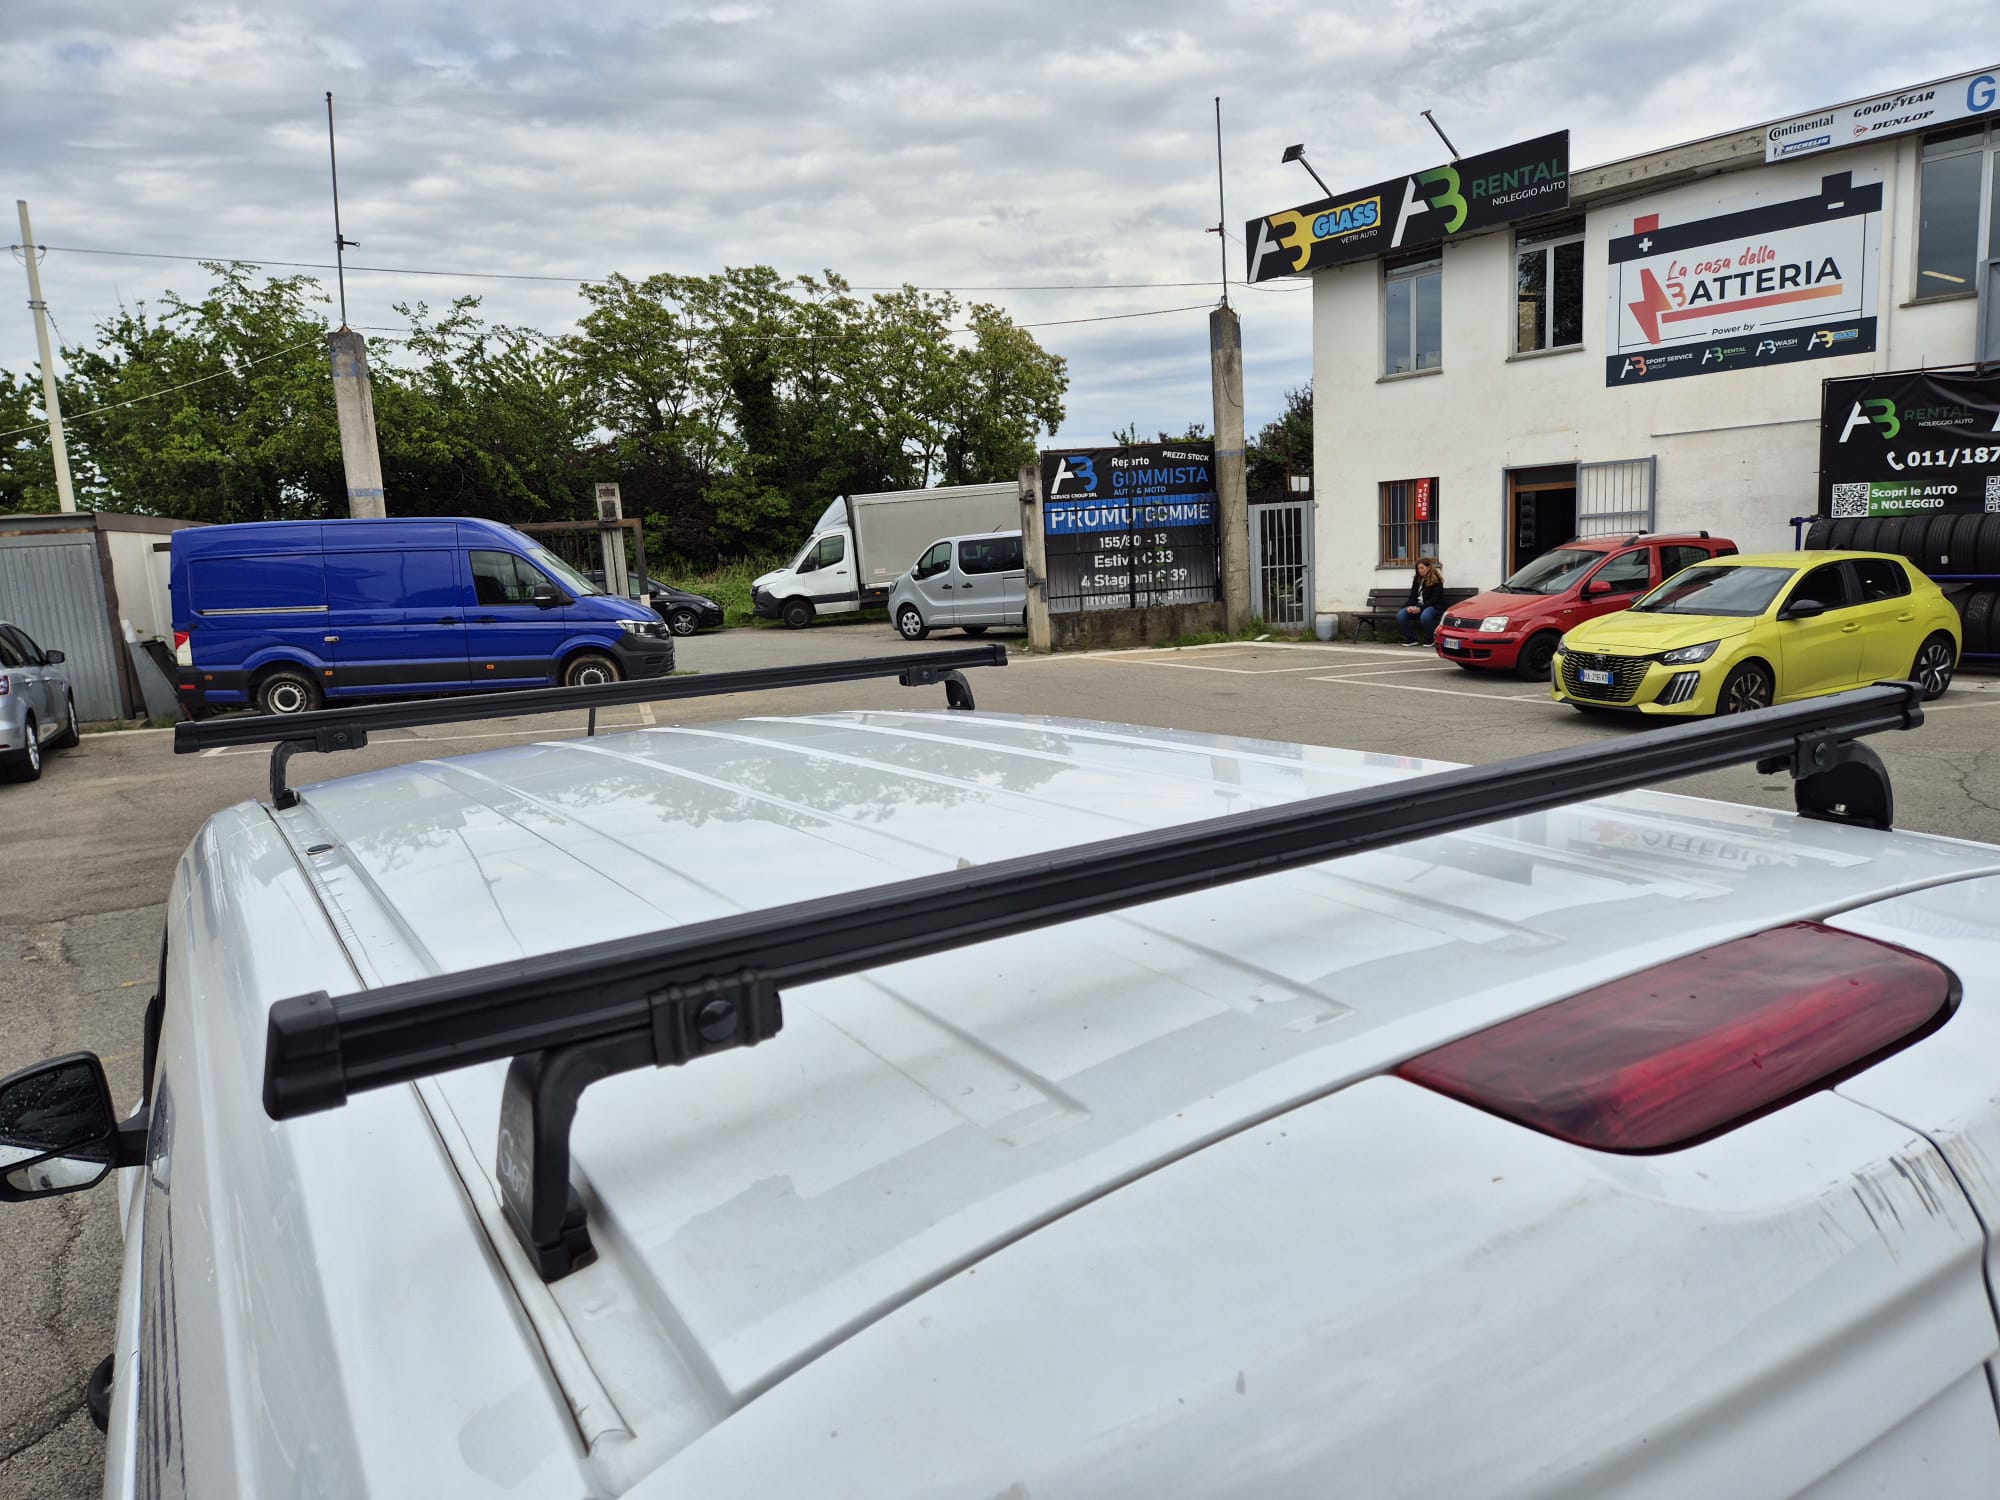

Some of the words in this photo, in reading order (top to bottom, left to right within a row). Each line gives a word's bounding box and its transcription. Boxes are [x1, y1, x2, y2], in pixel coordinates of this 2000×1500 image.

[1967, 75, 1996, 112] G
[1853, 91, 1935, 118] GOODYEAR
[1769, 114, 1834, 141] Continental
[1871, 110, 1934, 131] DUNLOP
[1784, 137, 1829, 152] MICHELIN
[1472, 158, 1567, 200] RENTAL
[1492, 188, 1538, 206] NOLEGGIO
[1540, 180, 1566, 195] AUTO
[1312, 201, 1378, 238] GLASS
[1341, 234, 1358, 244] VETRI
[1360, 230, 1378, 240] AUTO
[1667, 260, 1687, 281] La
[1694, 256, 1731, 275] casa
[1739, 245, 1775, 267] della
[1711, 324, 1740, 336] Power
[1742, 322, 1755, 333] by
[1775, 338, 1798, 347] WASH
[1646, 357, 1666, 365] SPORT
[1667, 353, 1693, 362] SERVICE
[1904, 405, 1973, 421] RENTAL
[1918, 419, 1953, 427] NOLEGGIO
[1163, 451, 1186, 460] PREZZI
[1187, 453, 1209, 461] STOCK
[1907, 446, 2000, 468] 011/187
[1871, 486, 1907, 498] Scopri
[1910, 486, 1921, 496] le
[1923, 485, 1957, 496] AUTO
[1146, 503, 1210, 522] GOMME
[1881, 499, 1944, 510] NOLEGGIO
[1155, 533, 1167, 545] 13
[1156, 551, 1174, 564] 33
[1081, 576, 1090, 587] 4
[1170, 568, 1187, 581] 39
